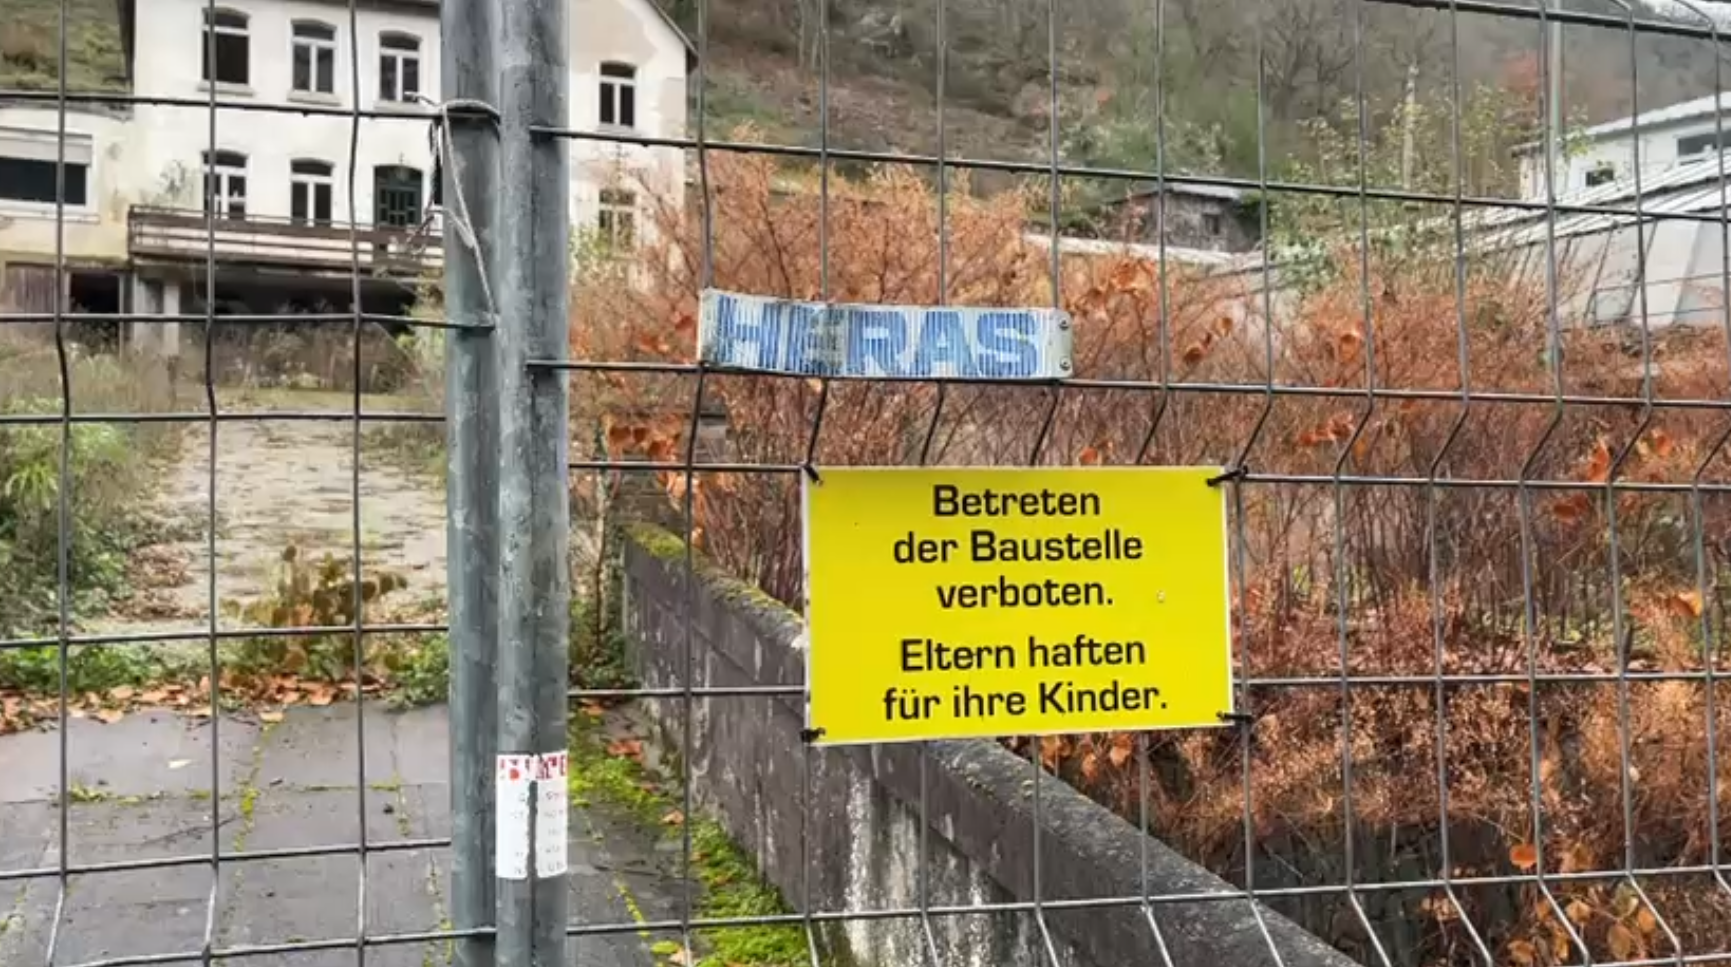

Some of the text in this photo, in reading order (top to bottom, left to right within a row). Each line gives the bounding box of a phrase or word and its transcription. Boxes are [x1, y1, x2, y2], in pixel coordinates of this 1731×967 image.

[716, 295, 1038, 378] HERAS
[933, 484, 1101, 518] Betreten
[893, 529, 1144, 564] der Baustelle
[936, 576, 1114, 609] verboten.
[900, 634, 1147, 672] Eltern haften
[883, 680, 1168, 721] für ihre Kinder.
